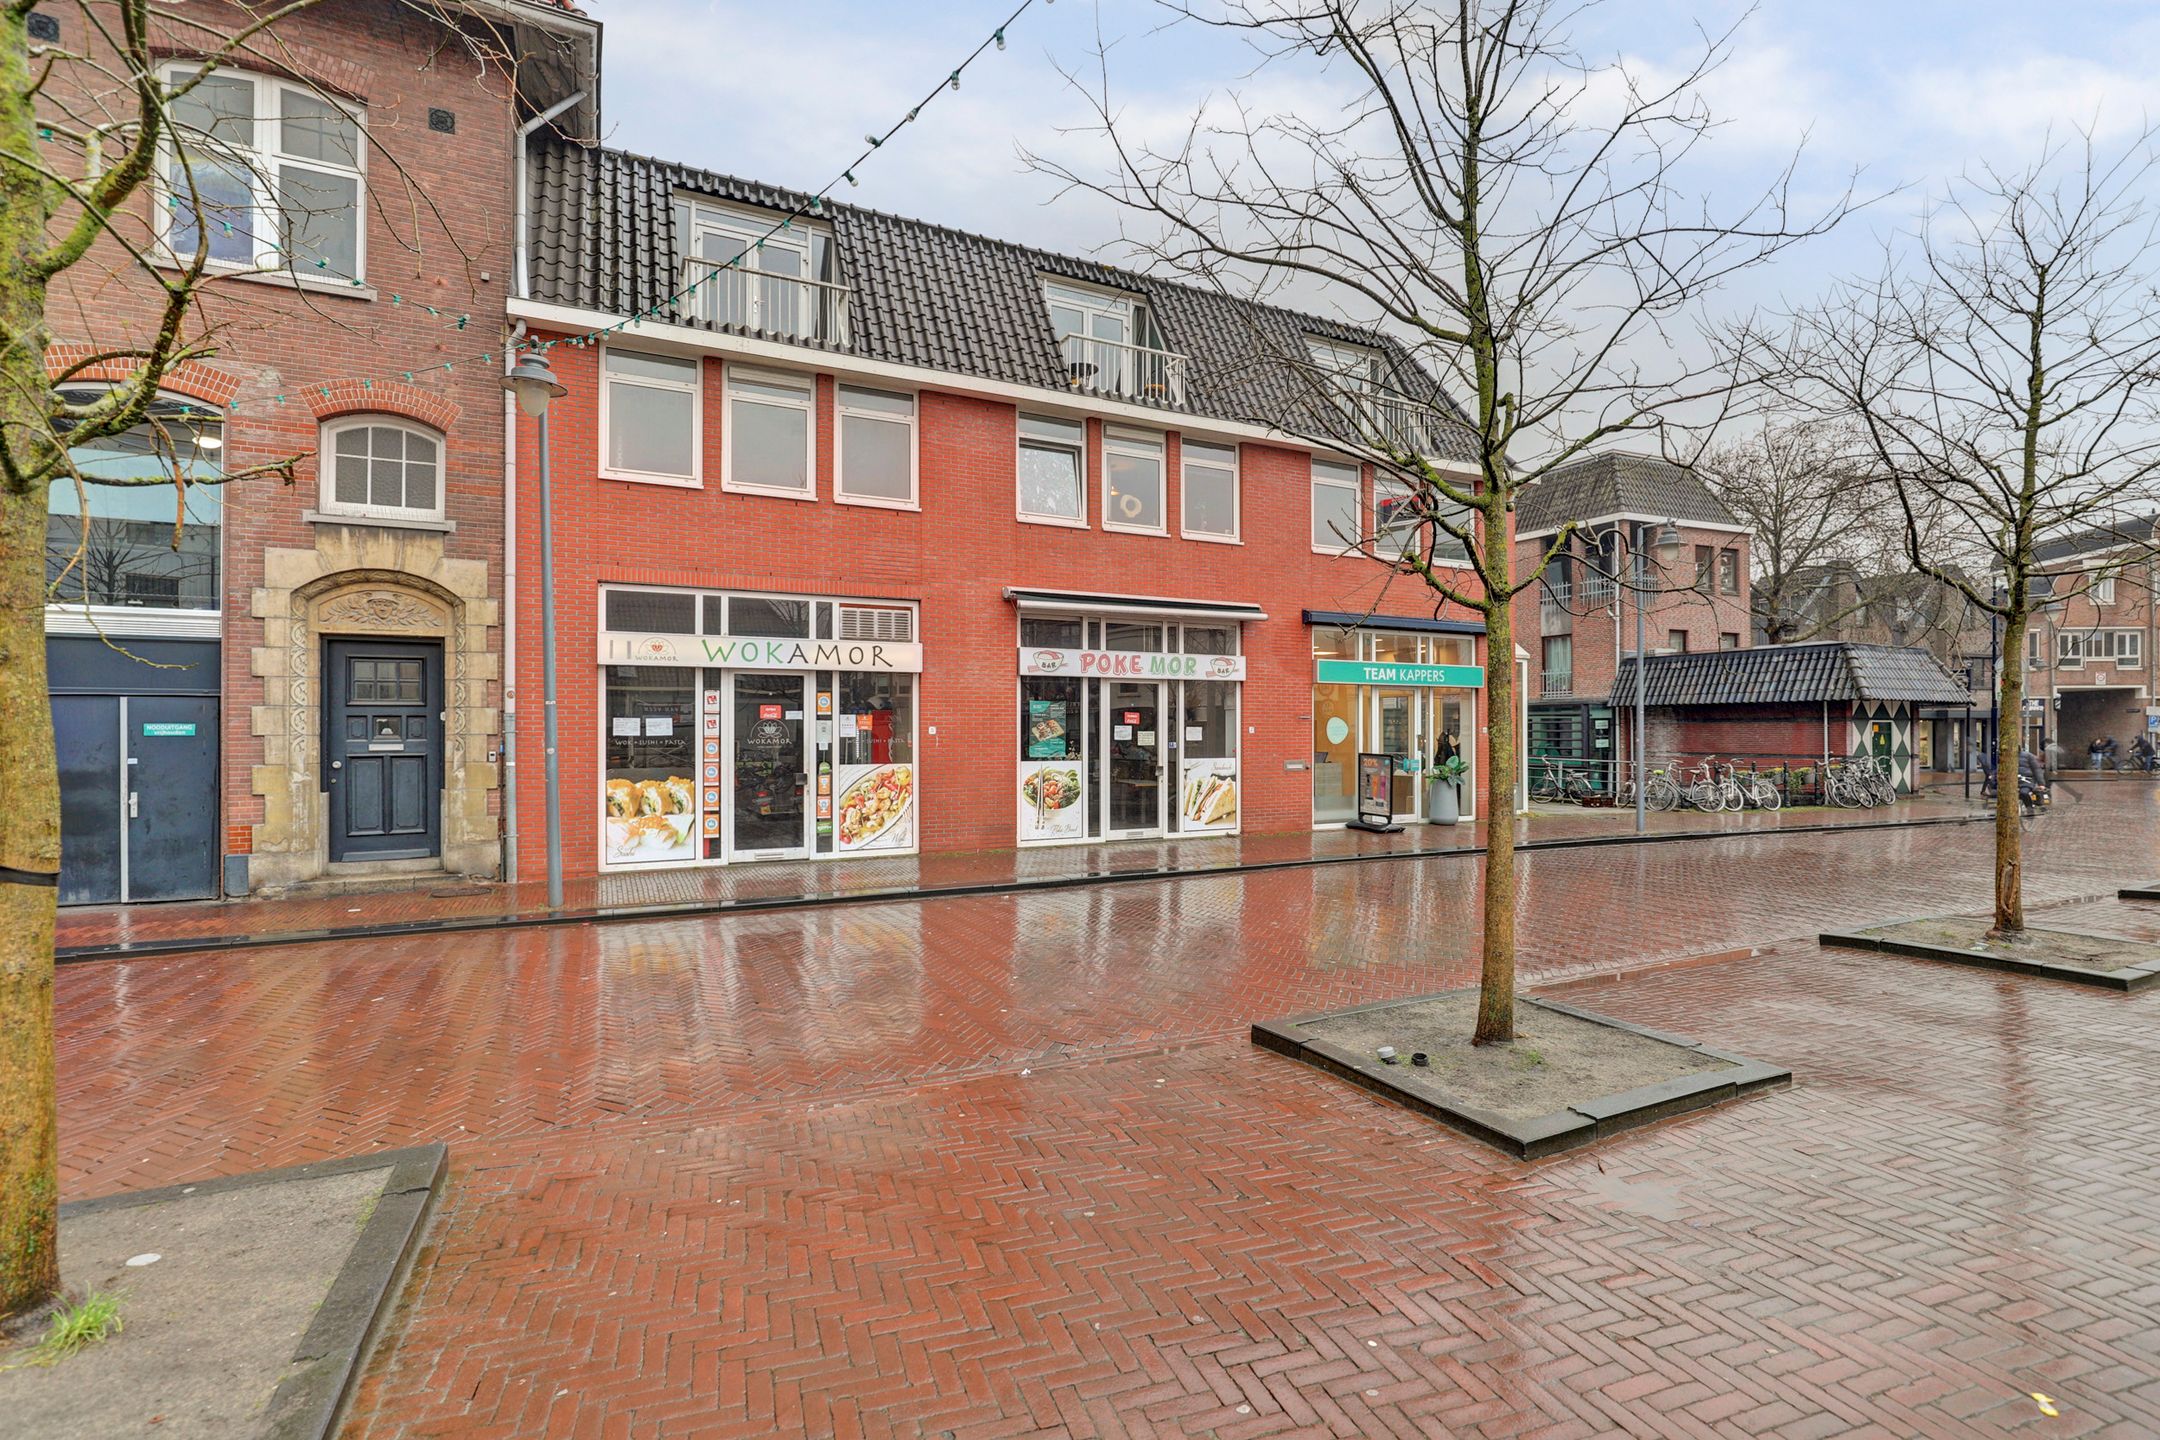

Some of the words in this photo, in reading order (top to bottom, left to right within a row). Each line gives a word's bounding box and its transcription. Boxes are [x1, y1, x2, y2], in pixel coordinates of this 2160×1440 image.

[701, 639, 893, 667] WOKAMOR
[1079, 652, 1143, 676] POKE
[1149, 655, 1197, 677] MOR
[1363, 667, 1396, 681] TEAM
[1400, 669, 1445, 682] KAPPERS
